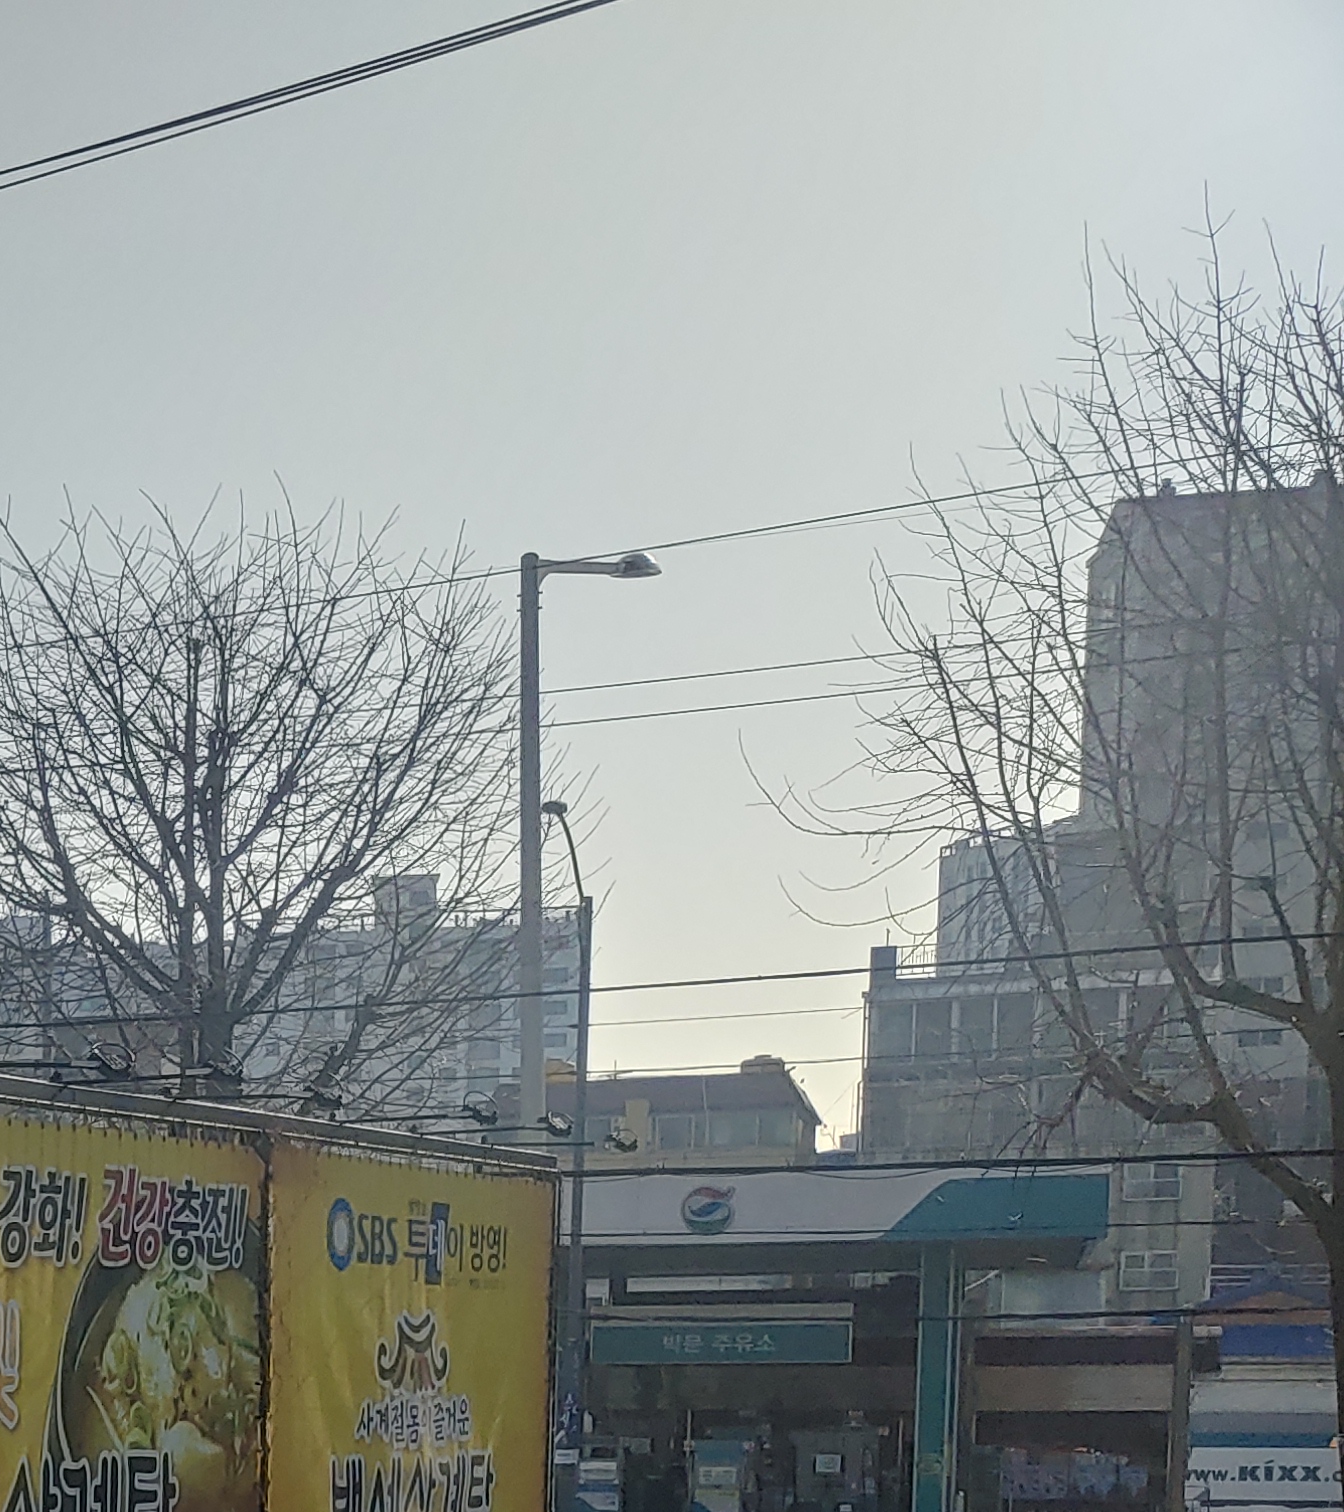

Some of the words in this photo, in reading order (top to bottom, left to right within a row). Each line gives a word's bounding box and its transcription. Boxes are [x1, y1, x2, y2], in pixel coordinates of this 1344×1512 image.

[100, 1169, 248, 1266] 건강충전!
[357, 1214, 398, 1265] SBS
[470, 1225, 507, 1272] 방영!
